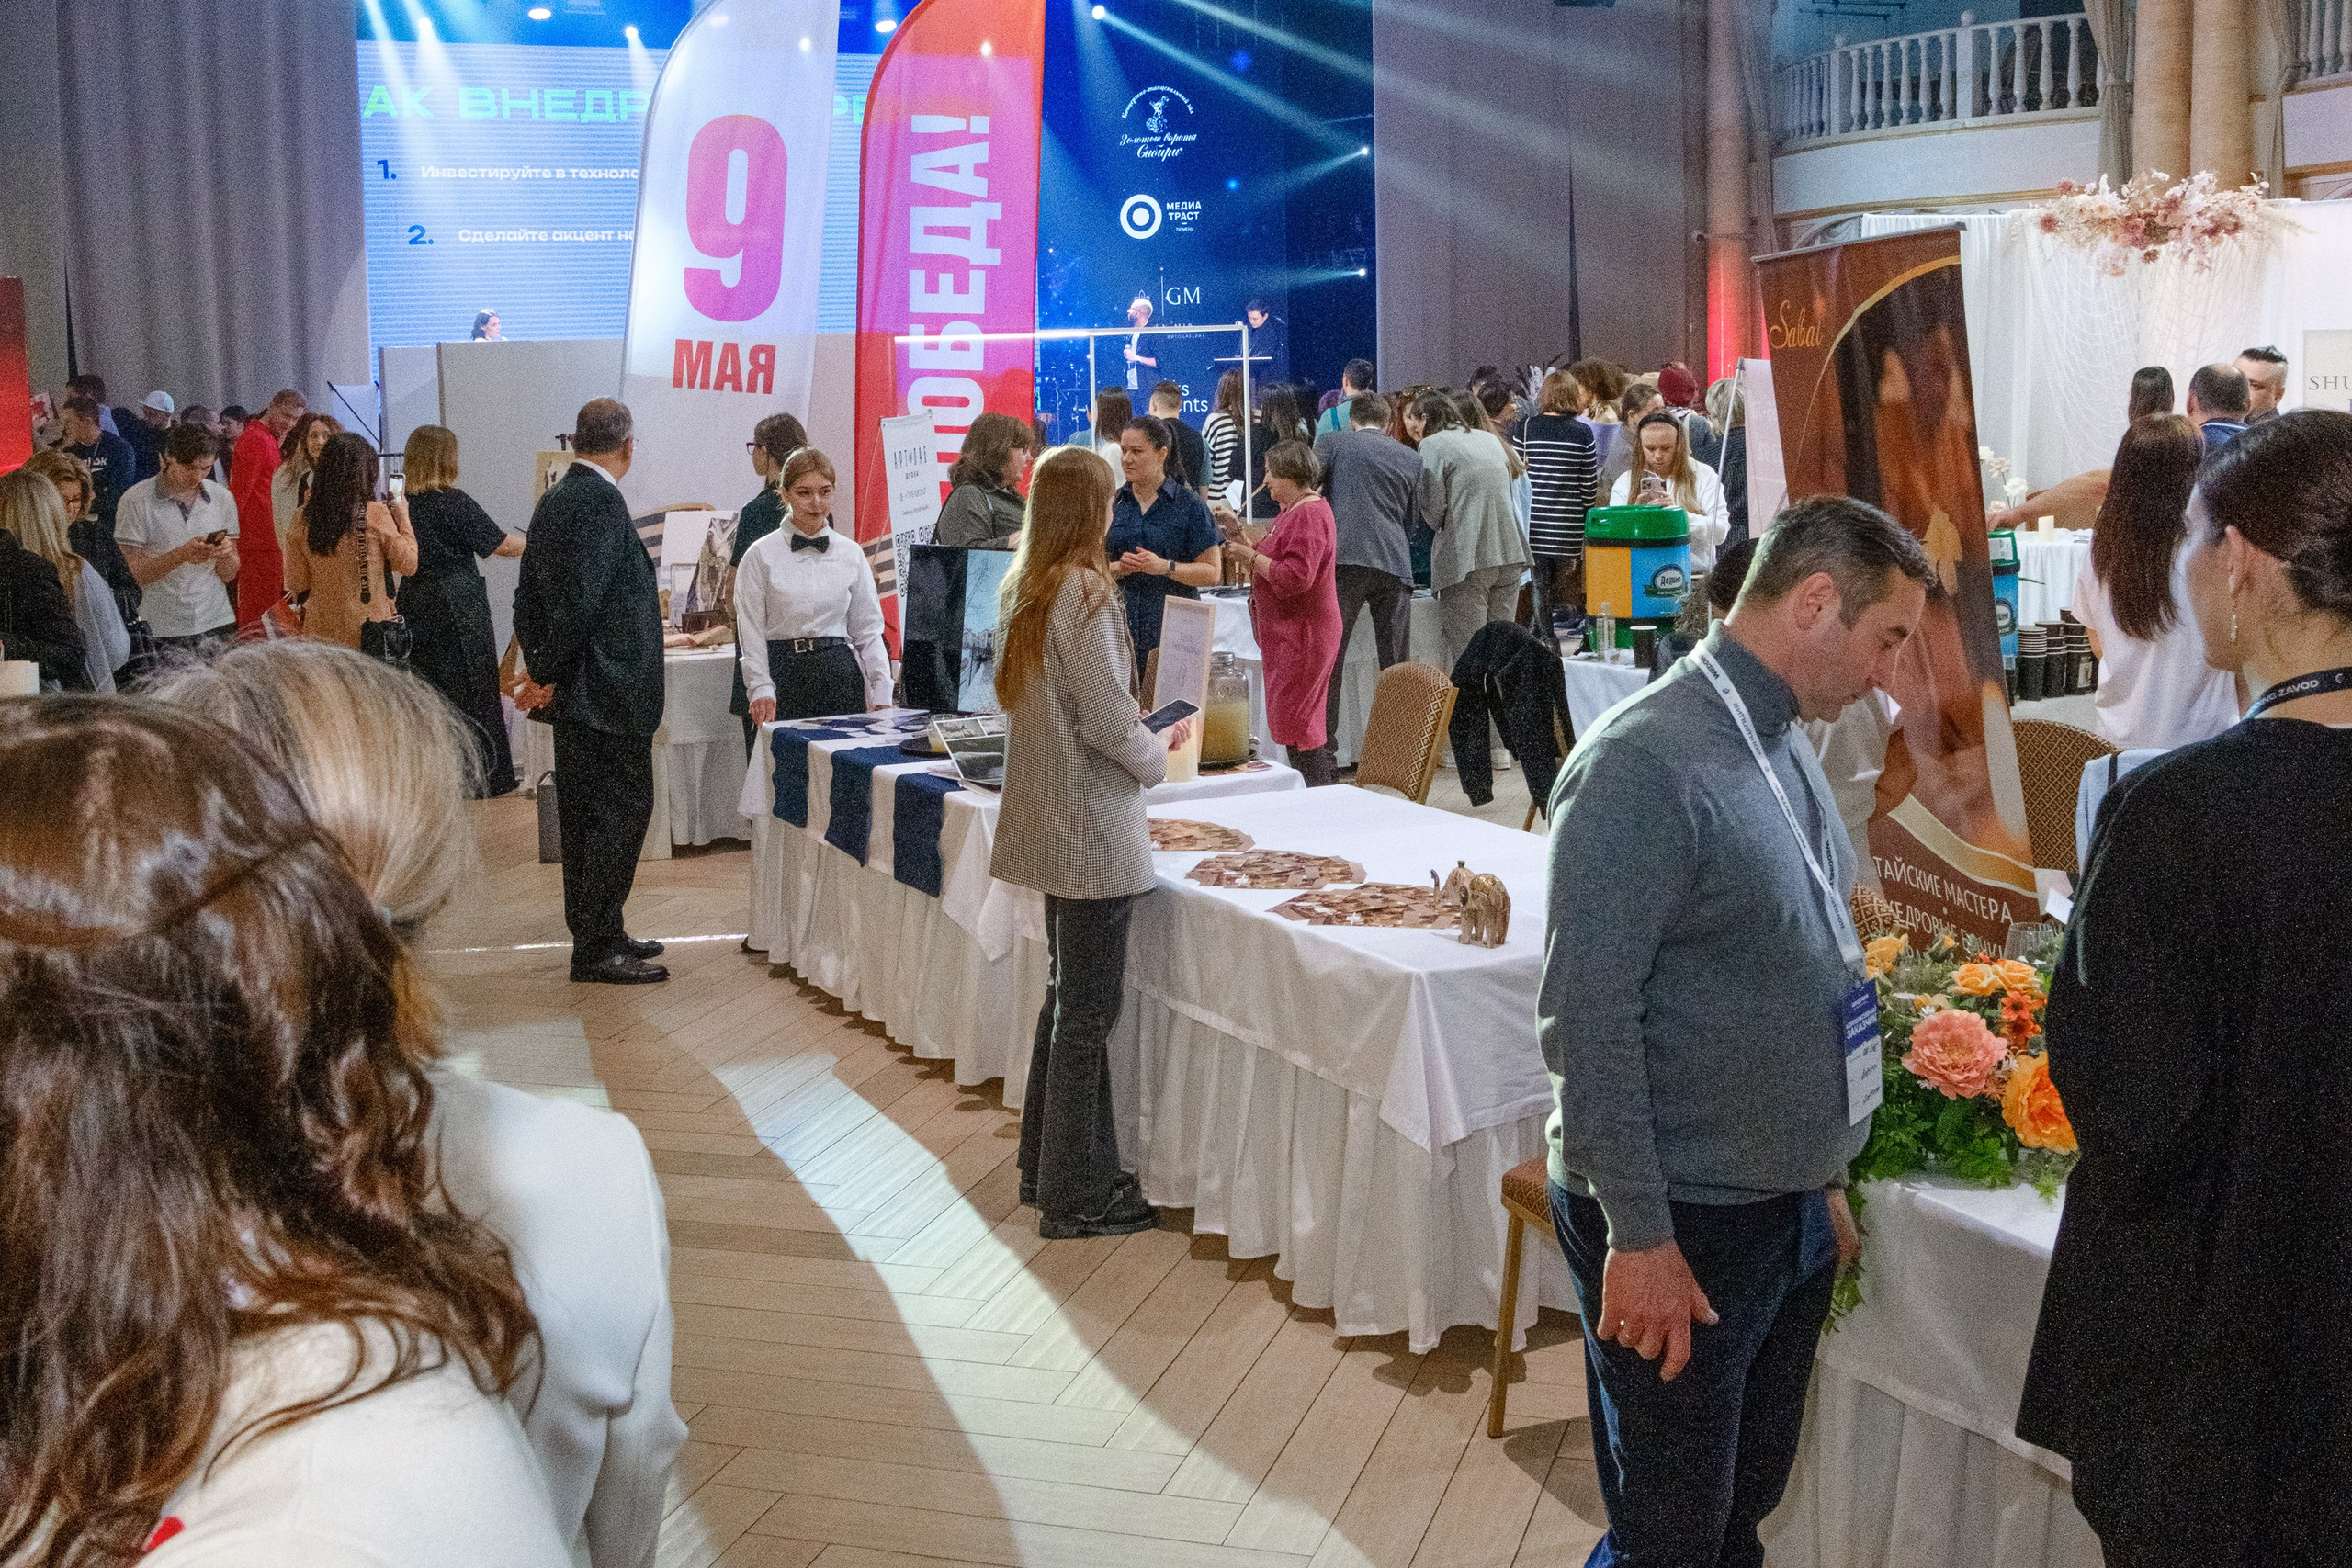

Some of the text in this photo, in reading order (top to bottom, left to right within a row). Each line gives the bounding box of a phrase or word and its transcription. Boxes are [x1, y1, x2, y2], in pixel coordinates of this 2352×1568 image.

[458, 87, 650, 123] ВНЕДР
[1136, 144, 1183, 162] Сибири
[378, 160, 397, 179] 1.
[422, 165, 551, 180] Инвестируйте
[556, 168, 566, 178] в
[1166, 201, 1202, 211] МЕДИА
[684, 115, 788, 322] 9
[1168, 212, 1200, 220] ТРАСТ
[407, 225, 434, 245] 2.
[458, 229, 549, 243] Сделайте
[552, 231, 613, 243] акцент
[1167, 287, 1201, 305] GM
[672, 338, 776, 394] МАЯ
[1179, 399, 1208, 412] nts
[2278, 680, 2319, 698] ZAVOD
[1873, 855, 2014, 926] ТАЙСКИЕ МАСТЕРА
